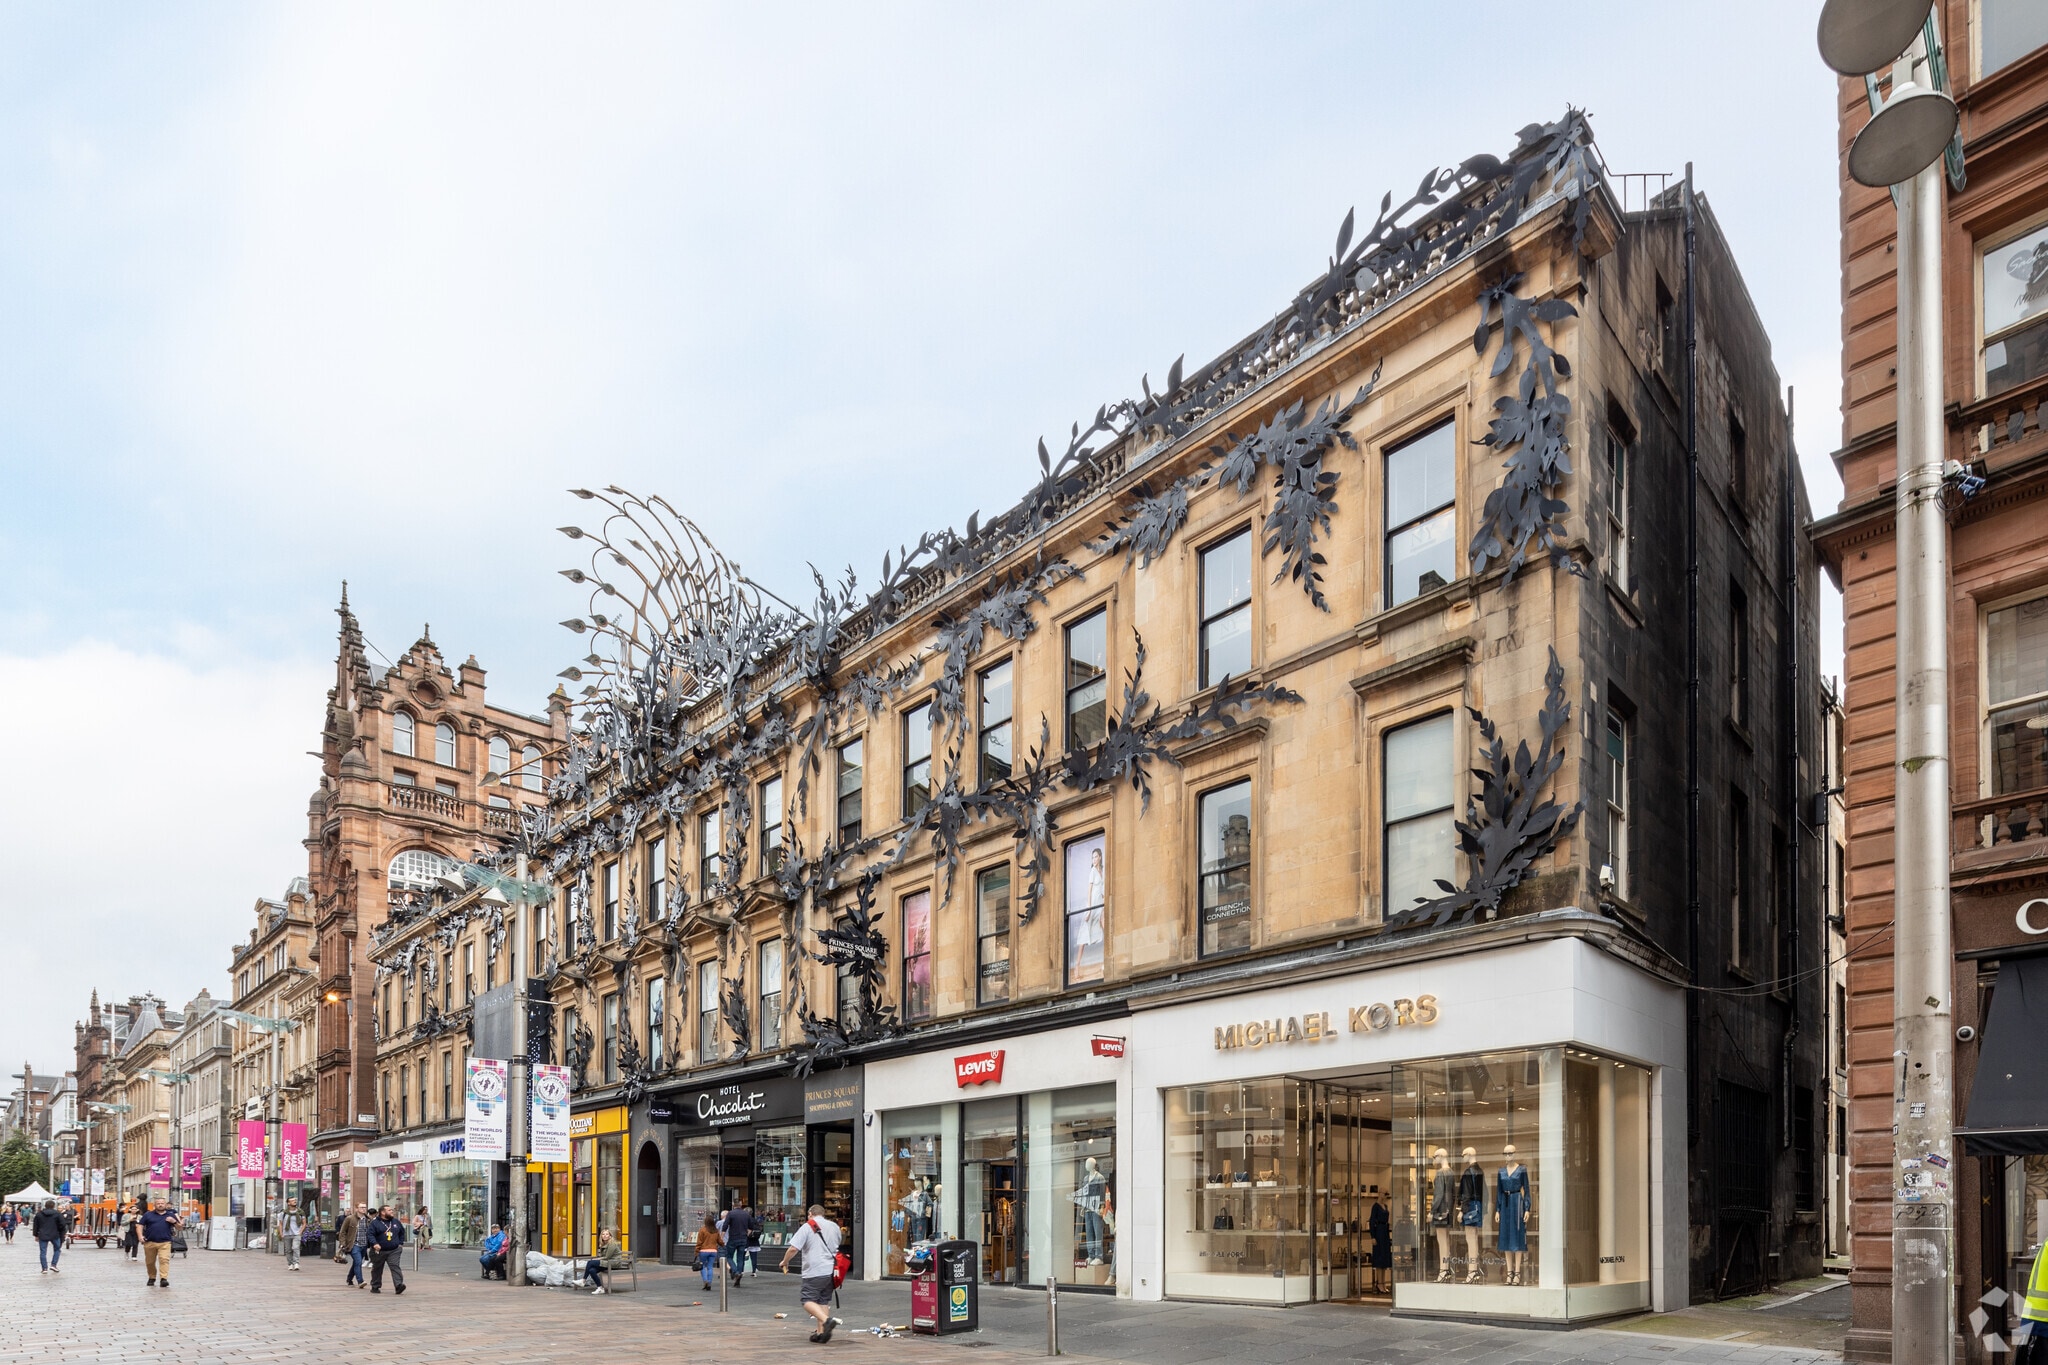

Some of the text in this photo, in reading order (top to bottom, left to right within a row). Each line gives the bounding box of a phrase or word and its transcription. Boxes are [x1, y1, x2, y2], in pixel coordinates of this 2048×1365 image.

[1207, 906, 1251, 921] CONNECTION
[1215, 901, 1244, 912] FRENCH
[829, 938, 878, 954] PRINCES SQUARE
[1214, 994, 1438, 1050] MICHAEL KORS
[720, 1085, 740, 1096] HOTEL
[806, 1085, 860, 1101] PRINCES SQUARE
[809, 1102, 831, 1112] SHOPPING
[836, 1100, 854, 1109] DINING
[569, 1117, 593, 1130] OCCITANE
[722, 1117, 735, 1125] COCOA
[735, 1115, 751, 1123] GROWER
[241, 1137, 249, 1171] GLASGOW
[440, 1138, 465, 1155] OFFIC
[283, 1139, 291, 1172] GLASGOW
[290, 1153, 298, 1173] MAKE
[297, 1149, 305, 1173] PEOPLE
[1443, 1256, 1480, 1265] MICHAEL
